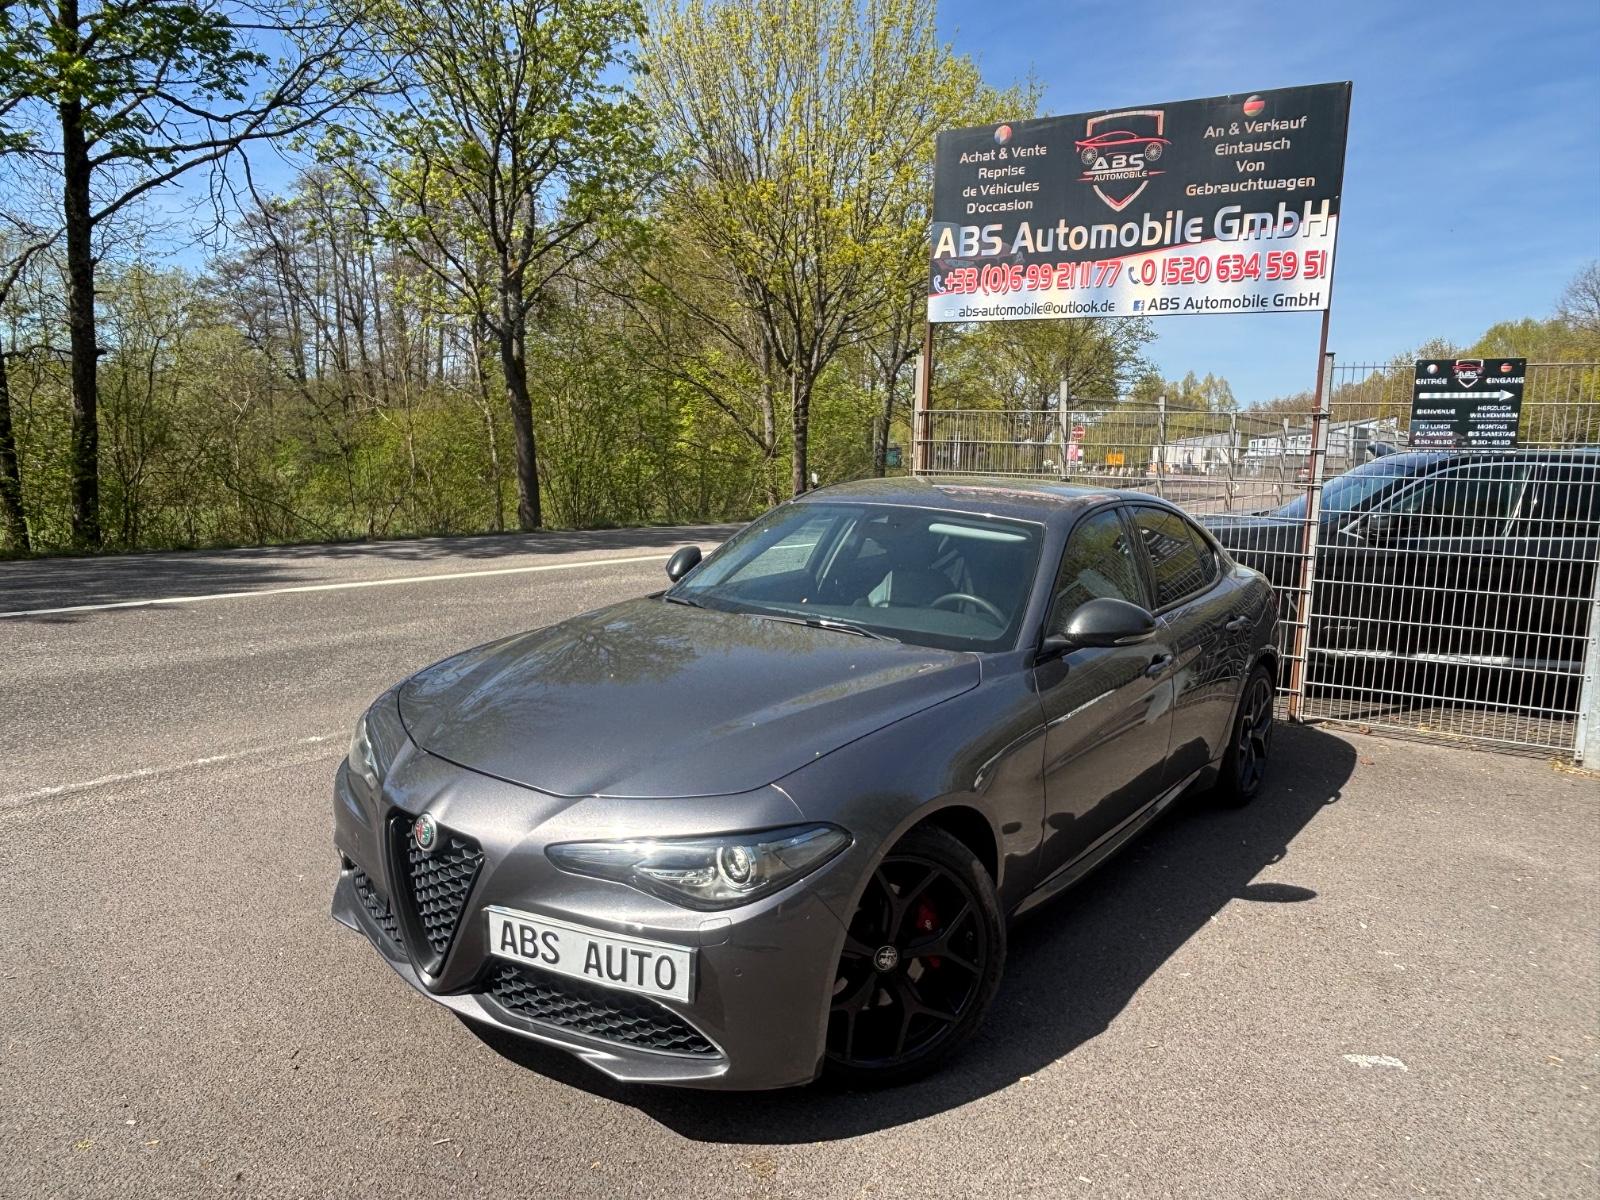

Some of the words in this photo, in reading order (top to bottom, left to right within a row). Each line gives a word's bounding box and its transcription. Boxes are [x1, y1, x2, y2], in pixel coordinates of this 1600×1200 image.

[1203, 126, 1224, 139] An
[1228, 122, 1240, 136] &
[1244, 116, 1308, 134] Verkauf
[959, 149, 995, 164] Achat
[999, 148, 1008, 160] &
[1012, 145, 1047, 158] Vente
[1214, 137, 1291, 156] Eintausch
[1091, 153, 1145, 171] ABS
[1236, 160, 1265, 173] Von
[978, 166, 1026, 180] Reprise
[1093, 170, 1148, 182] AUTOMOBILE
[962, 187, 977, 198] de
[981, 181, 1040, 195] Véhicules
[1186, 176, 1316, 196] Gebrauchtwagen
[966, 199, 1033, 214] D'occasion
[933, 223, 1003, 259] ABS
[1010, 210, 1204, 254] Automobile
[1213, 199, 1331, 241] GmbH
[1141, 258, 1156, 286] 0
[1161, 255, 1212, 285] 1520
[1215, 251, 1261, 282] 634
[1265, 250, 1299, 280] 59
[1303, 249, 1328, 279] 51
[944, 267, 978, 294] +33
[981, 263, 1024, 295] (0)6
[1025, 263, 1054, 290] 99
[1056, 261, 1076, 290] 21
[1079, 260, 1092, 289] 11
[1094, 260, 1123, 287] 77
[958, 300, 1115, 317] abs-automobile@outlook.de
[1148, 297, 1180, 311] ABS
[1183, 294, 1269, 310] Automobile
[1273, 292, 1320, 307] GmbH
[1486, 376, 1525, 384] EINGANG
[500, 919, 560, 965] ABS
[583, 940, 677, 991] AUTO
